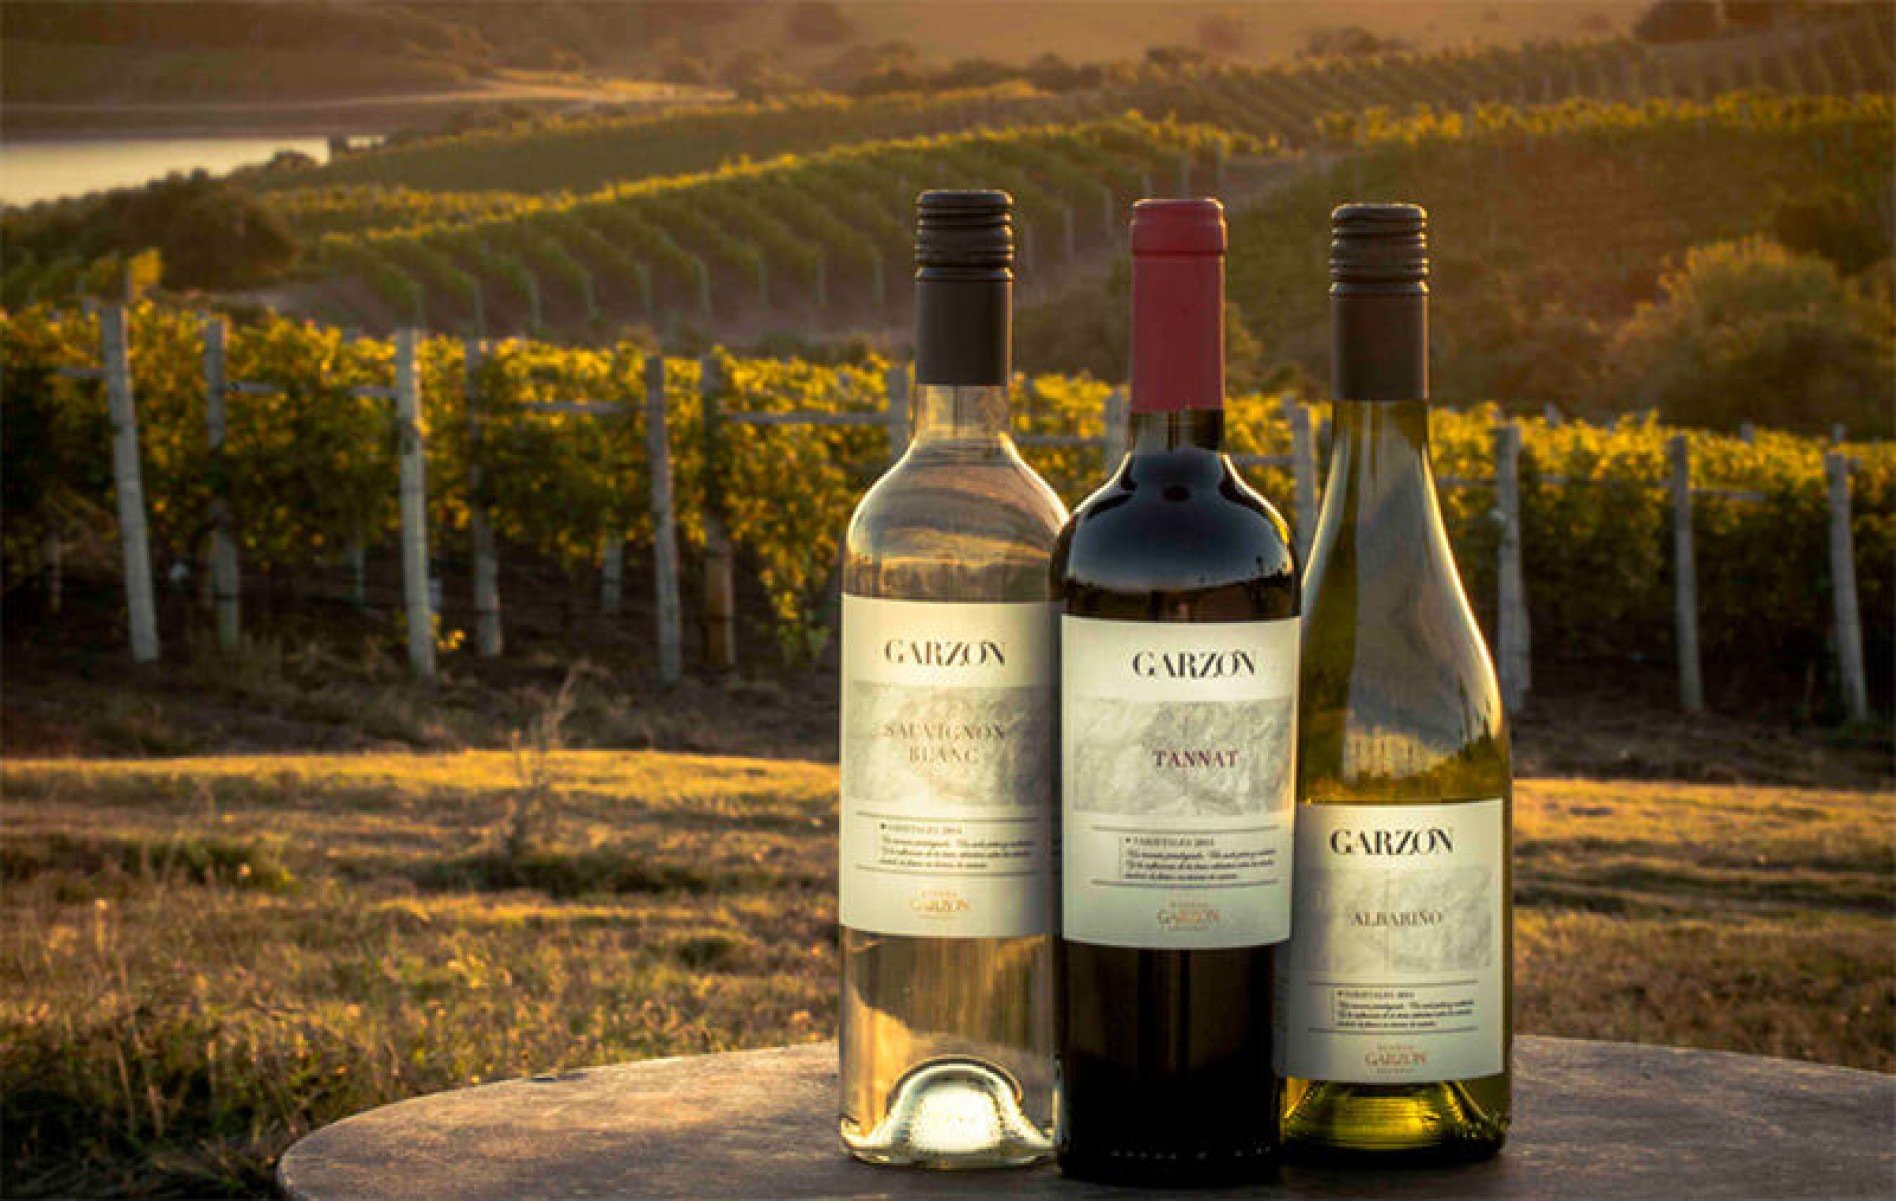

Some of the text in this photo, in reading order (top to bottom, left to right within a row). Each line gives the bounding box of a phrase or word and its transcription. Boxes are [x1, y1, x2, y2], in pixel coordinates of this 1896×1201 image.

[884, 722, 1006, 740] SAUVIGNON
[908, 747, 980, 763] BLANC
[1153, 750, 1239, 768] TANNAT
[1352, 910, 1443, 928] ALBARIÑO
